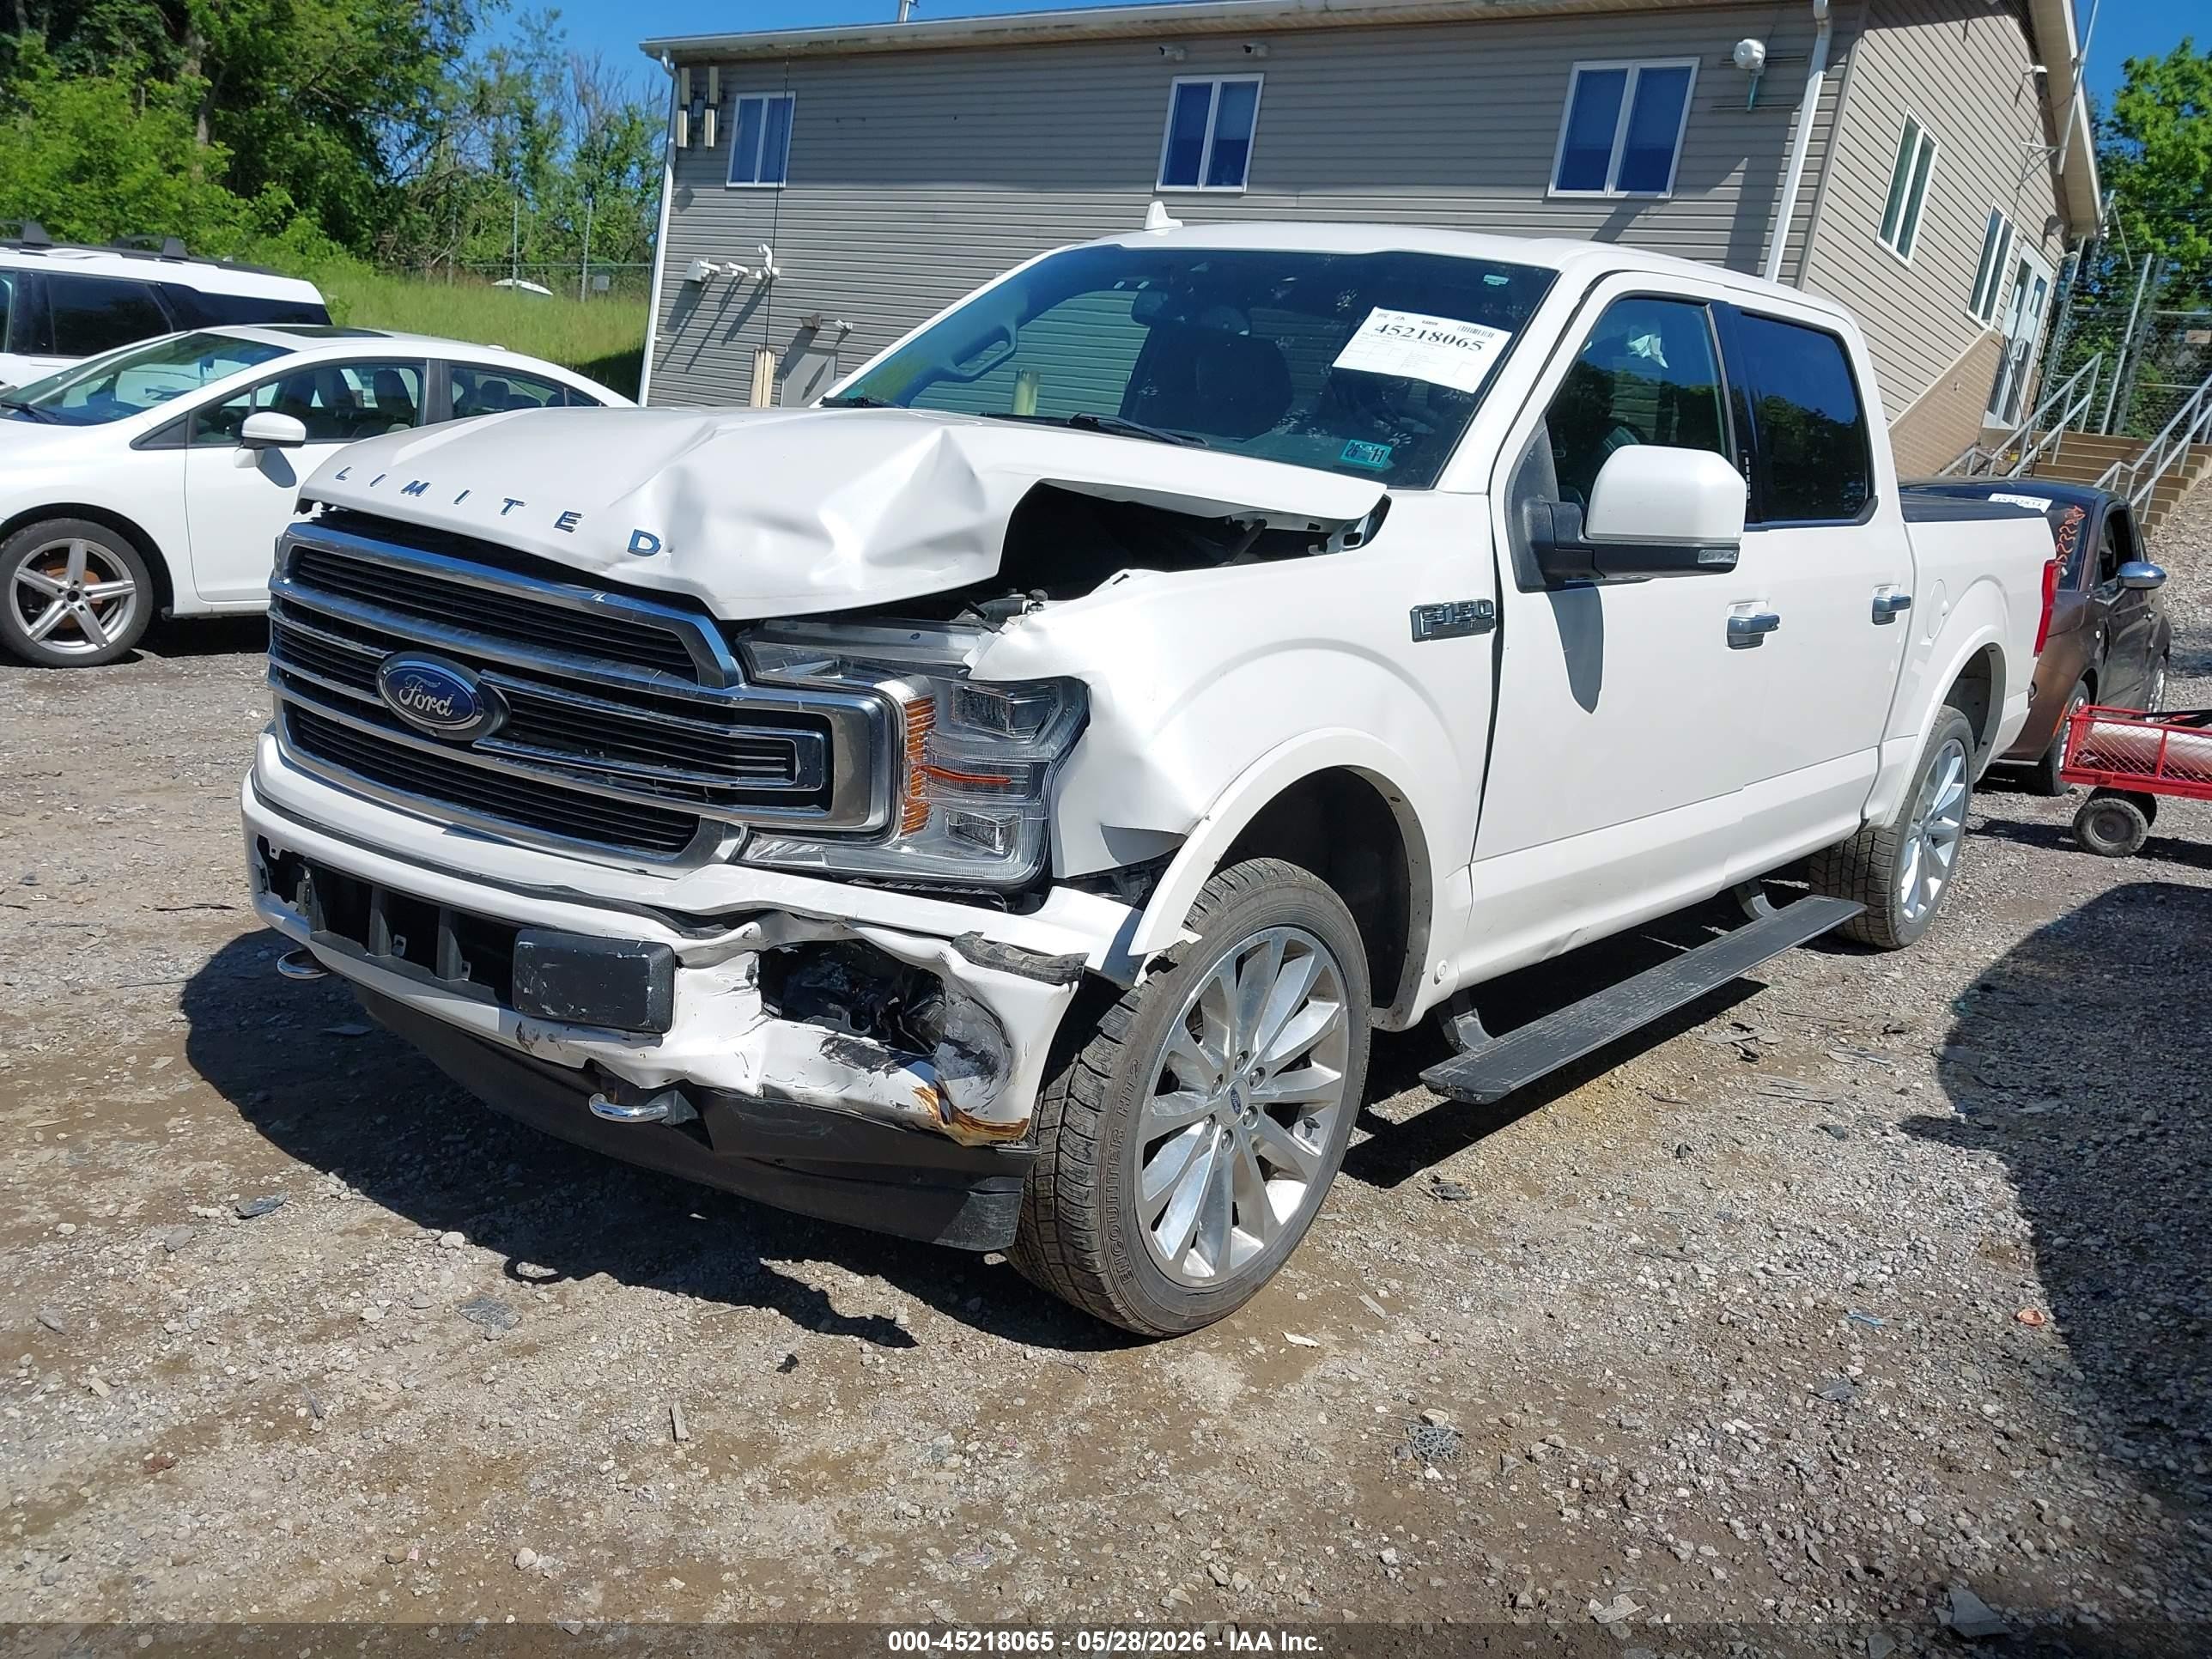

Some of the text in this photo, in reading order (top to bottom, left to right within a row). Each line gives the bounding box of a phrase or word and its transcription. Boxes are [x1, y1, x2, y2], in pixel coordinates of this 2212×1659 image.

[1376, 323, 1485, 351] 45218065
[335, 466, 661, 557] LIMITED
[399, 674, 455, 717] Ford
